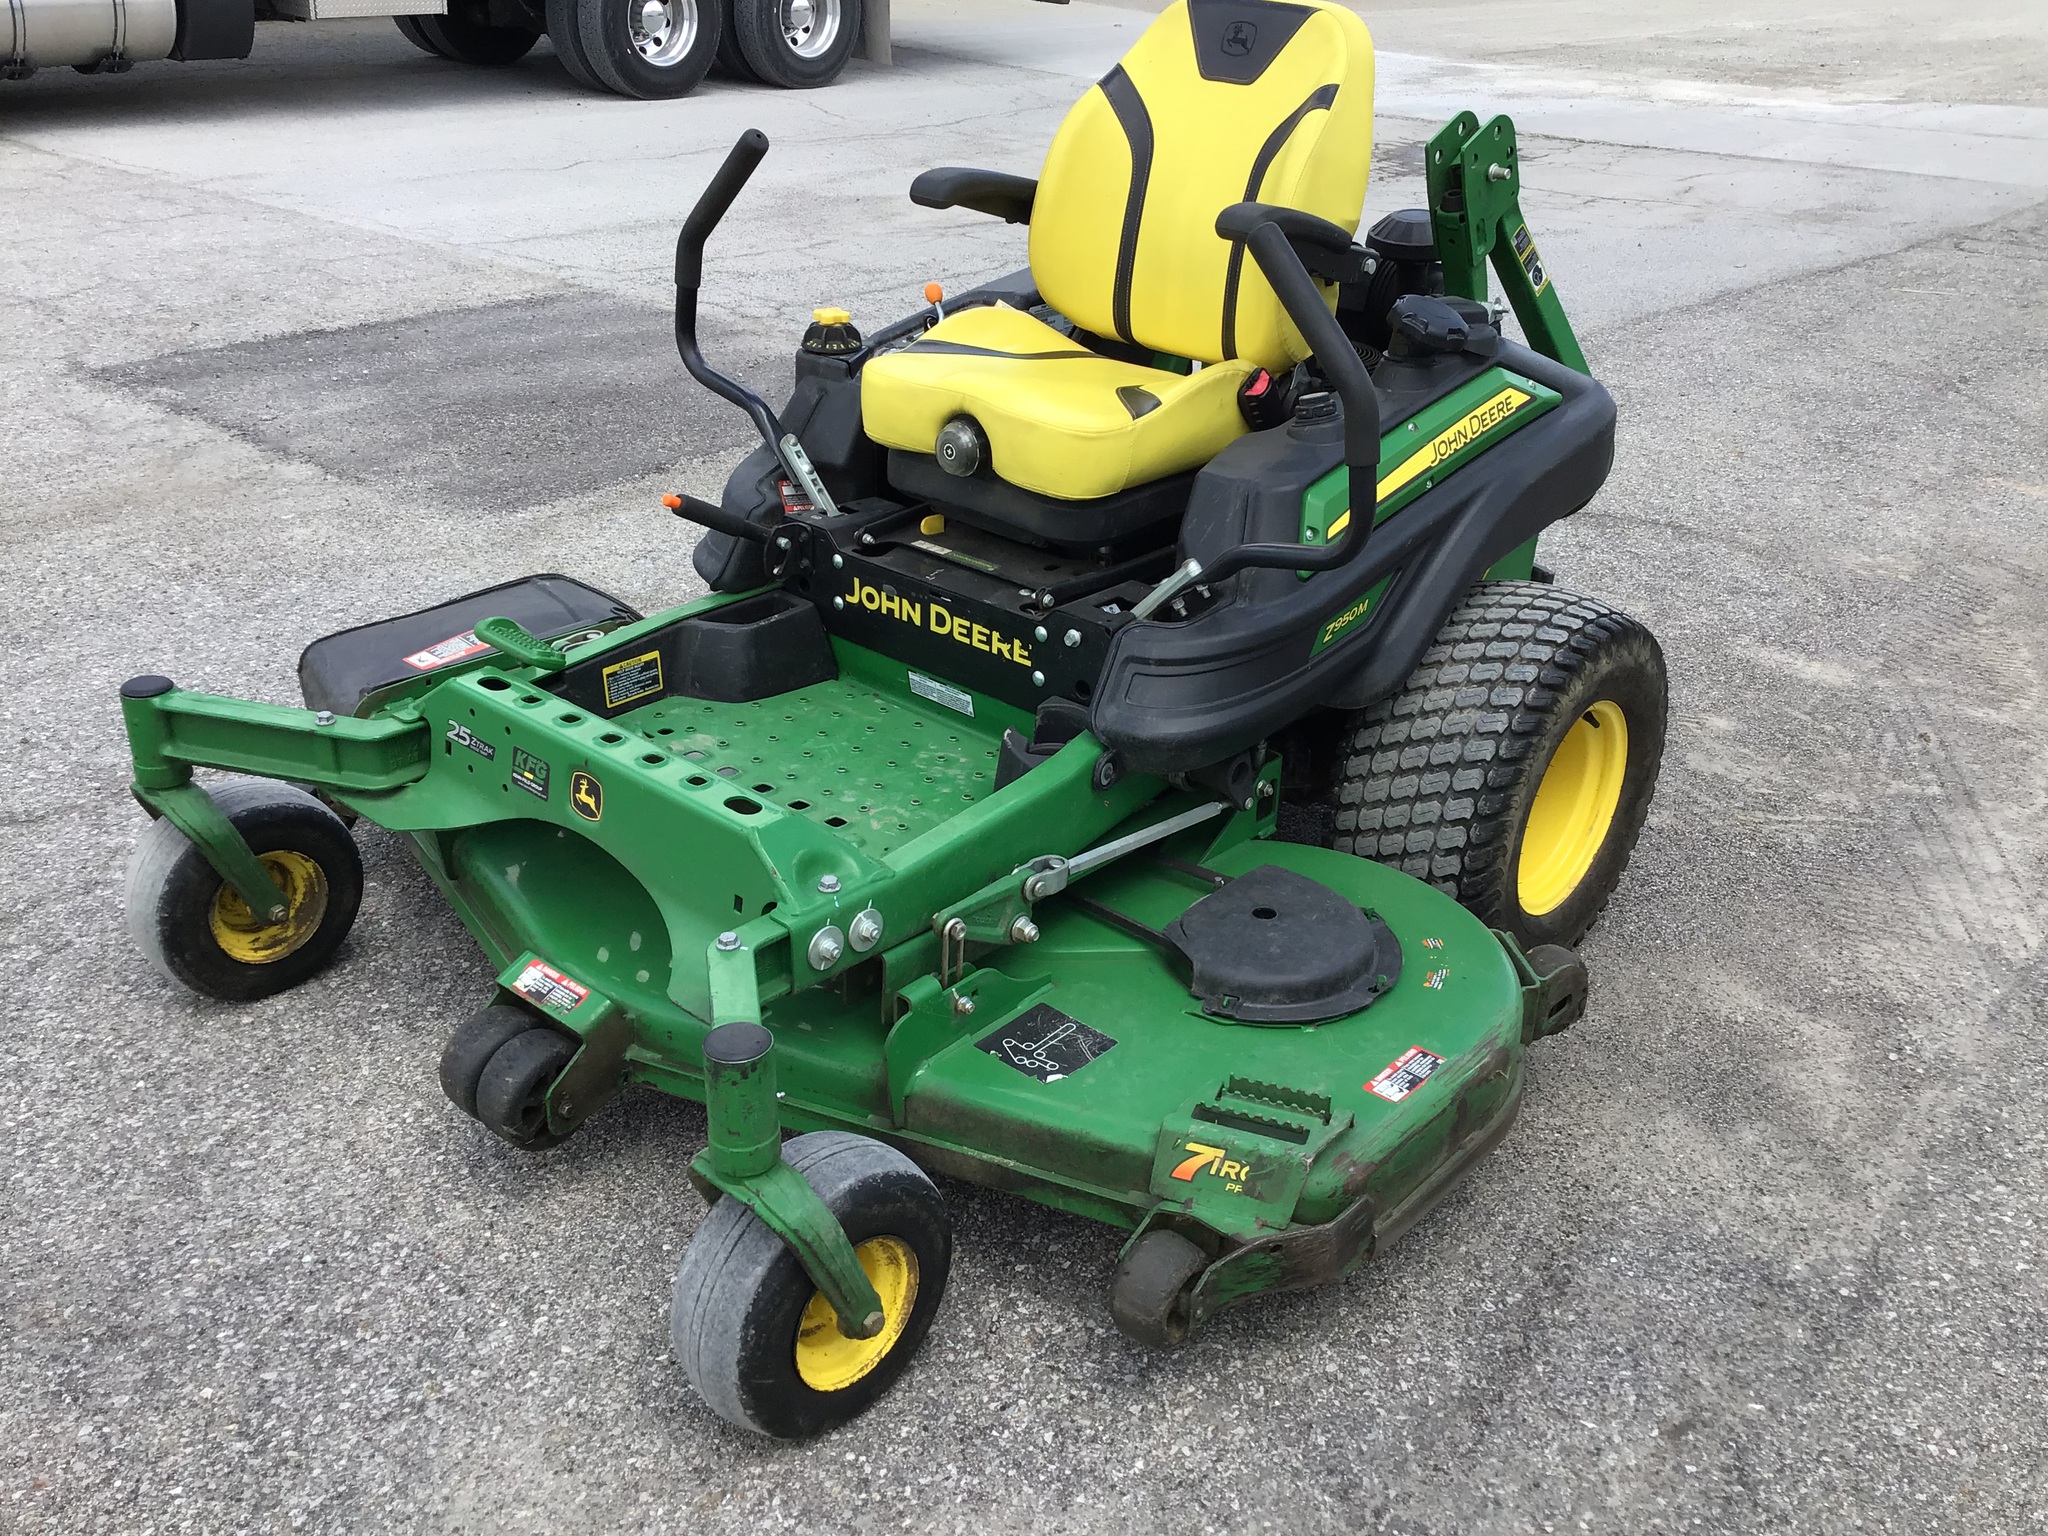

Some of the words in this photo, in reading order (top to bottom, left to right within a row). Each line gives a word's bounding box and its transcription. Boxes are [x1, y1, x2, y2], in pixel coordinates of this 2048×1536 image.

[1431, 425, 1468, 465] JOHN
[1469, 395, 1514, 436] DEERE
[845, 577, 921, 627] JOHN
[929, 602, 1032, 667] DEERE
[1323, 599, 1369, 643] Z950M
[446, 719, 472, 746] 25
[514, 750, 547, 779] KFG
